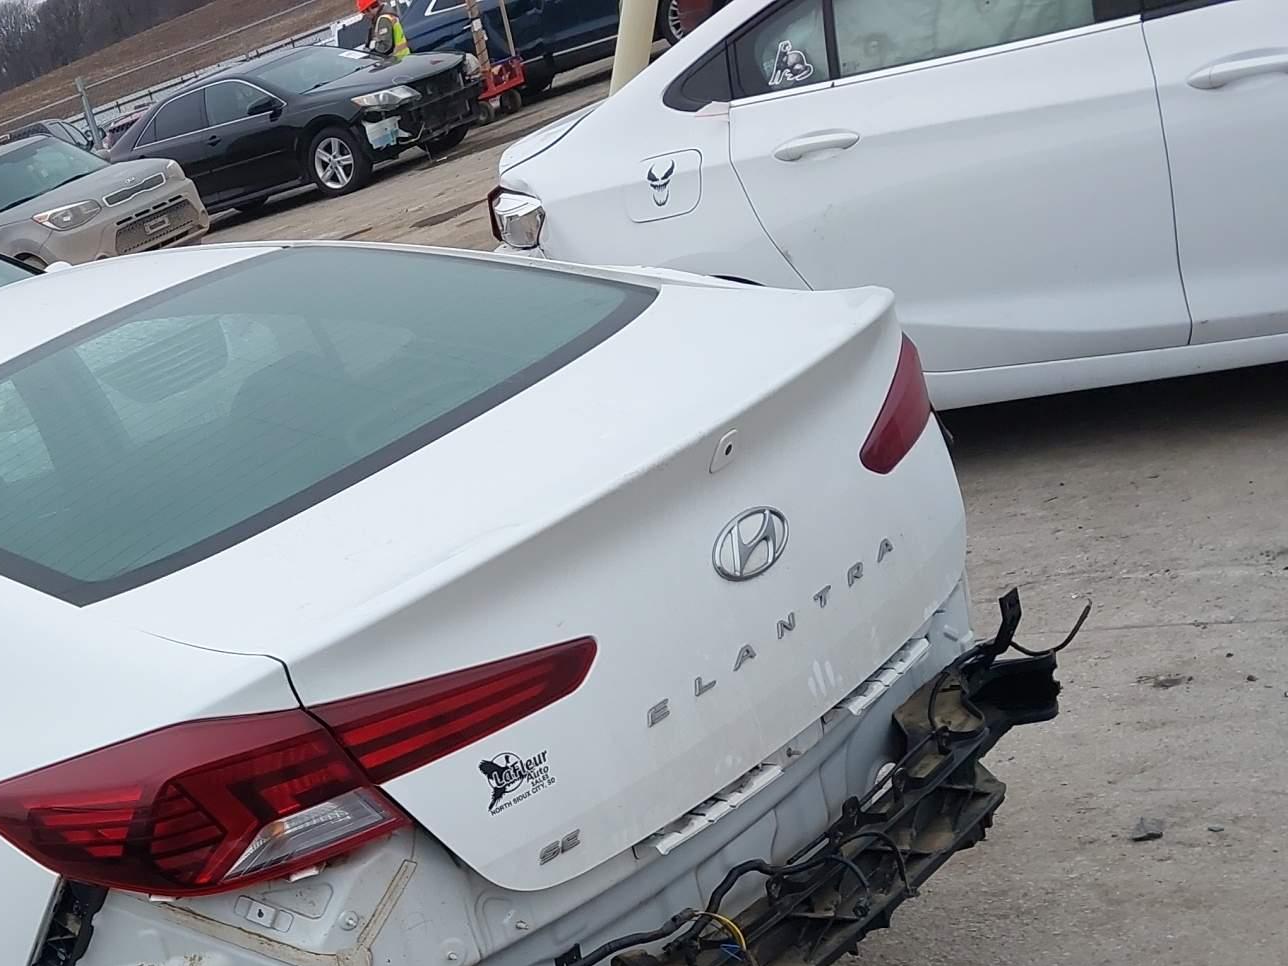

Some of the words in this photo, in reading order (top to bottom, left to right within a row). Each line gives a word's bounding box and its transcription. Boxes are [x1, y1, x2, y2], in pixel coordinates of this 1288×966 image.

[647, 537, 894, 728] ELANTRA
[493, 750, 547, 787] LaFleur
[526, 766, 549, 784] Auto
[490, 801, 513, 816] NORTH
[512, 790, 531, 804] SIOUX
[539, 829, 581, 866] SE
